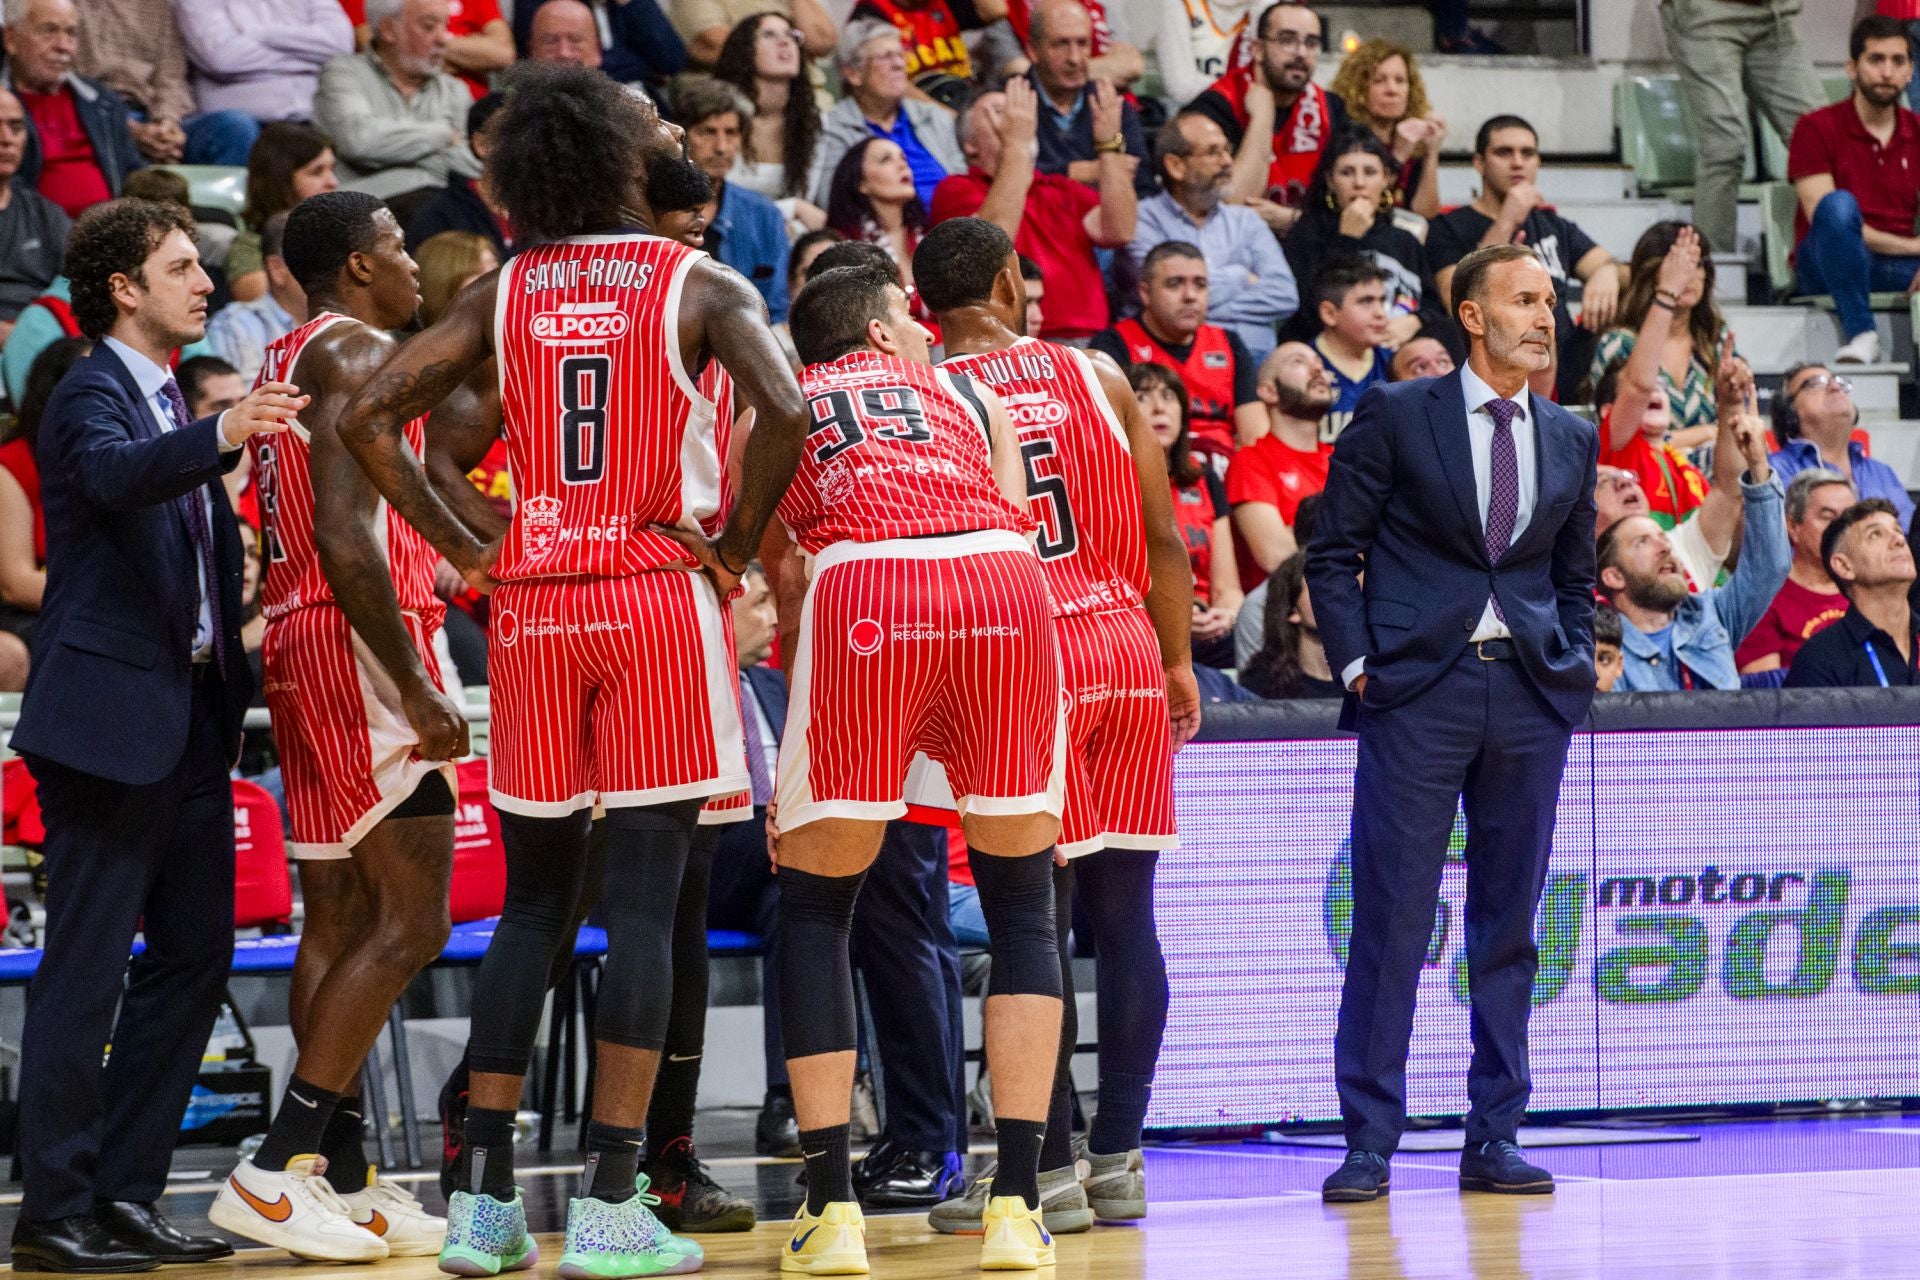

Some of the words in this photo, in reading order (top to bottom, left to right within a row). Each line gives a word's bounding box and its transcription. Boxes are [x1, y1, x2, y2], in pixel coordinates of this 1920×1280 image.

[525, 257, 653, 295] SANT-ROOS
[966, 354, 1056, 386] JULIUS
[559, 354, 612, 486] 8
[807, 385, 934, 464] 99
[559, 526, 628, 542] MURCI
[1061, 583, 1135, 615] MURCIA
[949, 628, 967, 640] DE
[971, 626, 1020, 637] MURCIA
[1600, 865, 1806, 907] motor
